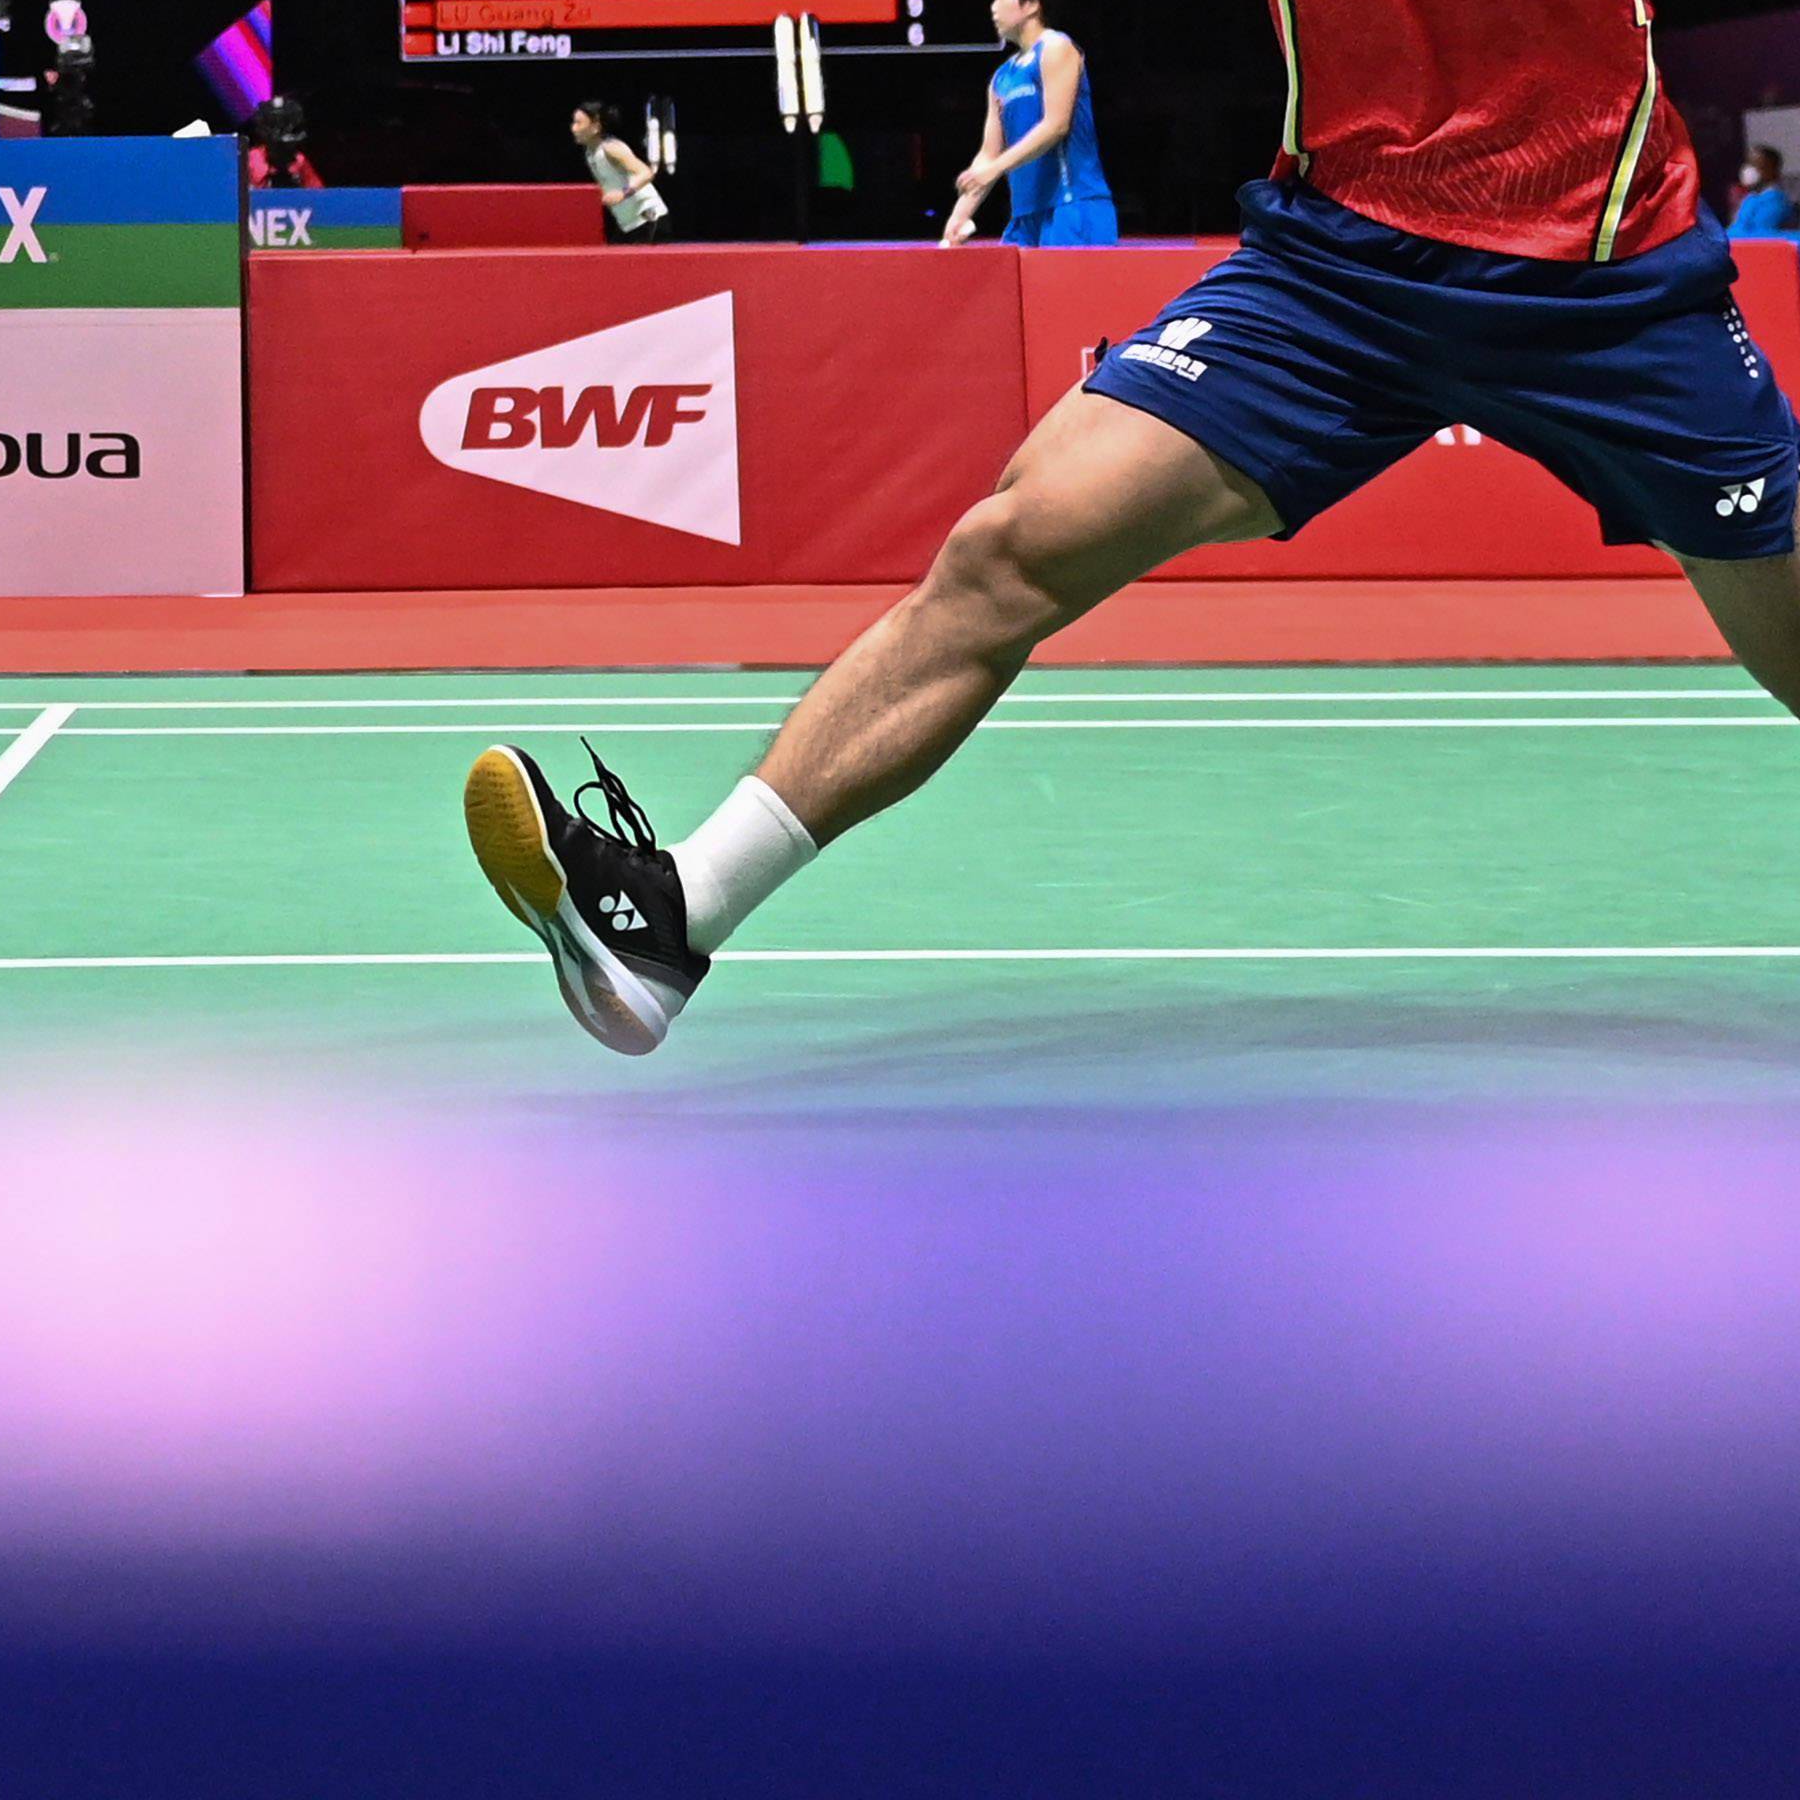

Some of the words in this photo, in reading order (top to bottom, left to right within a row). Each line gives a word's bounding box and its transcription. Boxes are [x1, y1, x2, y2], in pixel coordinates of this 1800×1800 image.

[436, 33, 460, 55] LI
[466, 31, 505, 54] Shi
[511, 30, 571, 57] Feng
[461, 383, 714, 450] BWF
